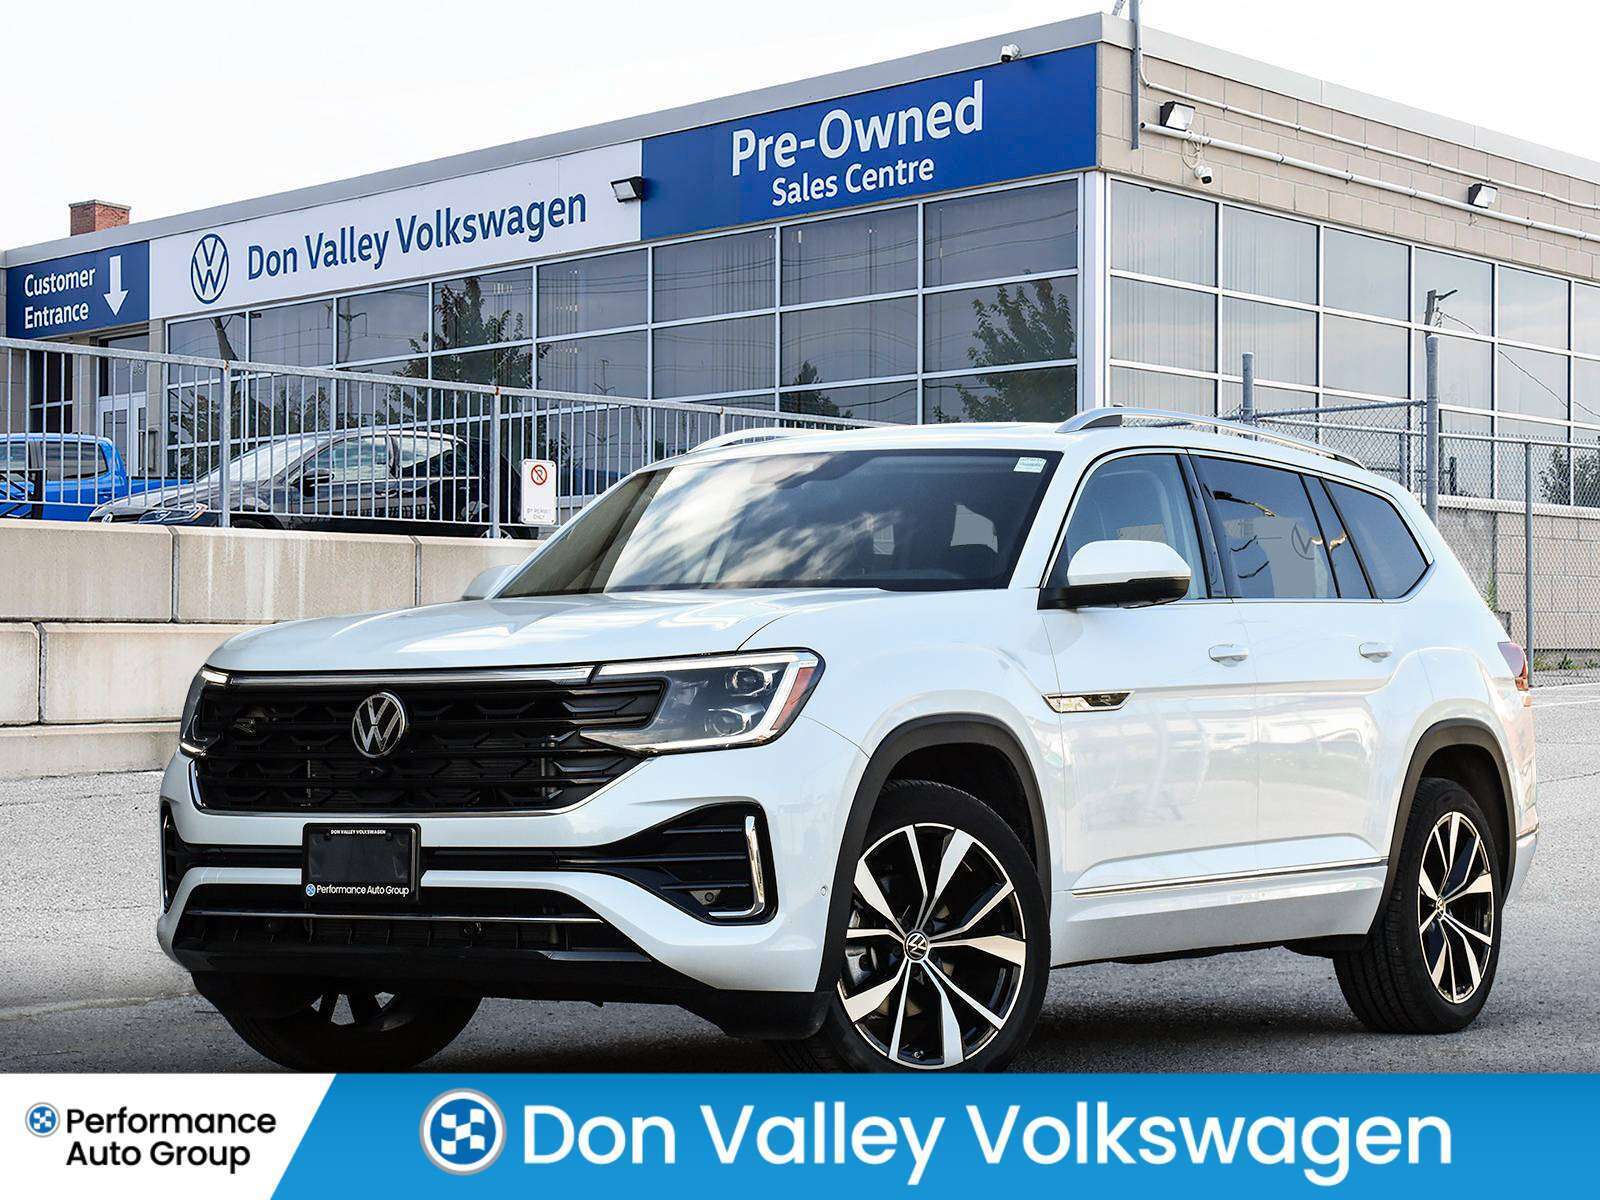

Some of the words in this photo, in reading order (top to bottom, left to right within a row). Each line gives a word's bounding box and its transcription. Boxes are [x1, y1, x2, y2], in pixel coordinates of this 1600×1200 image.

[731, 79, 984, 177] Pre-Owned
[772, 172, 838, 207] Sales
[845, 157, 935, 193] Centre
[247, 244, 298, 280] Don
[304, 226, 390, 270] Valley
[395, 192, 587, 254] Volkswagen
[24, 267, 96, 297] Customer
[24, 302, 89, 329] Entrance
[316, 884, 366, 894] Performance
[367, 885, 385, 895] Auto
[386, 885, 410, 898] Group
